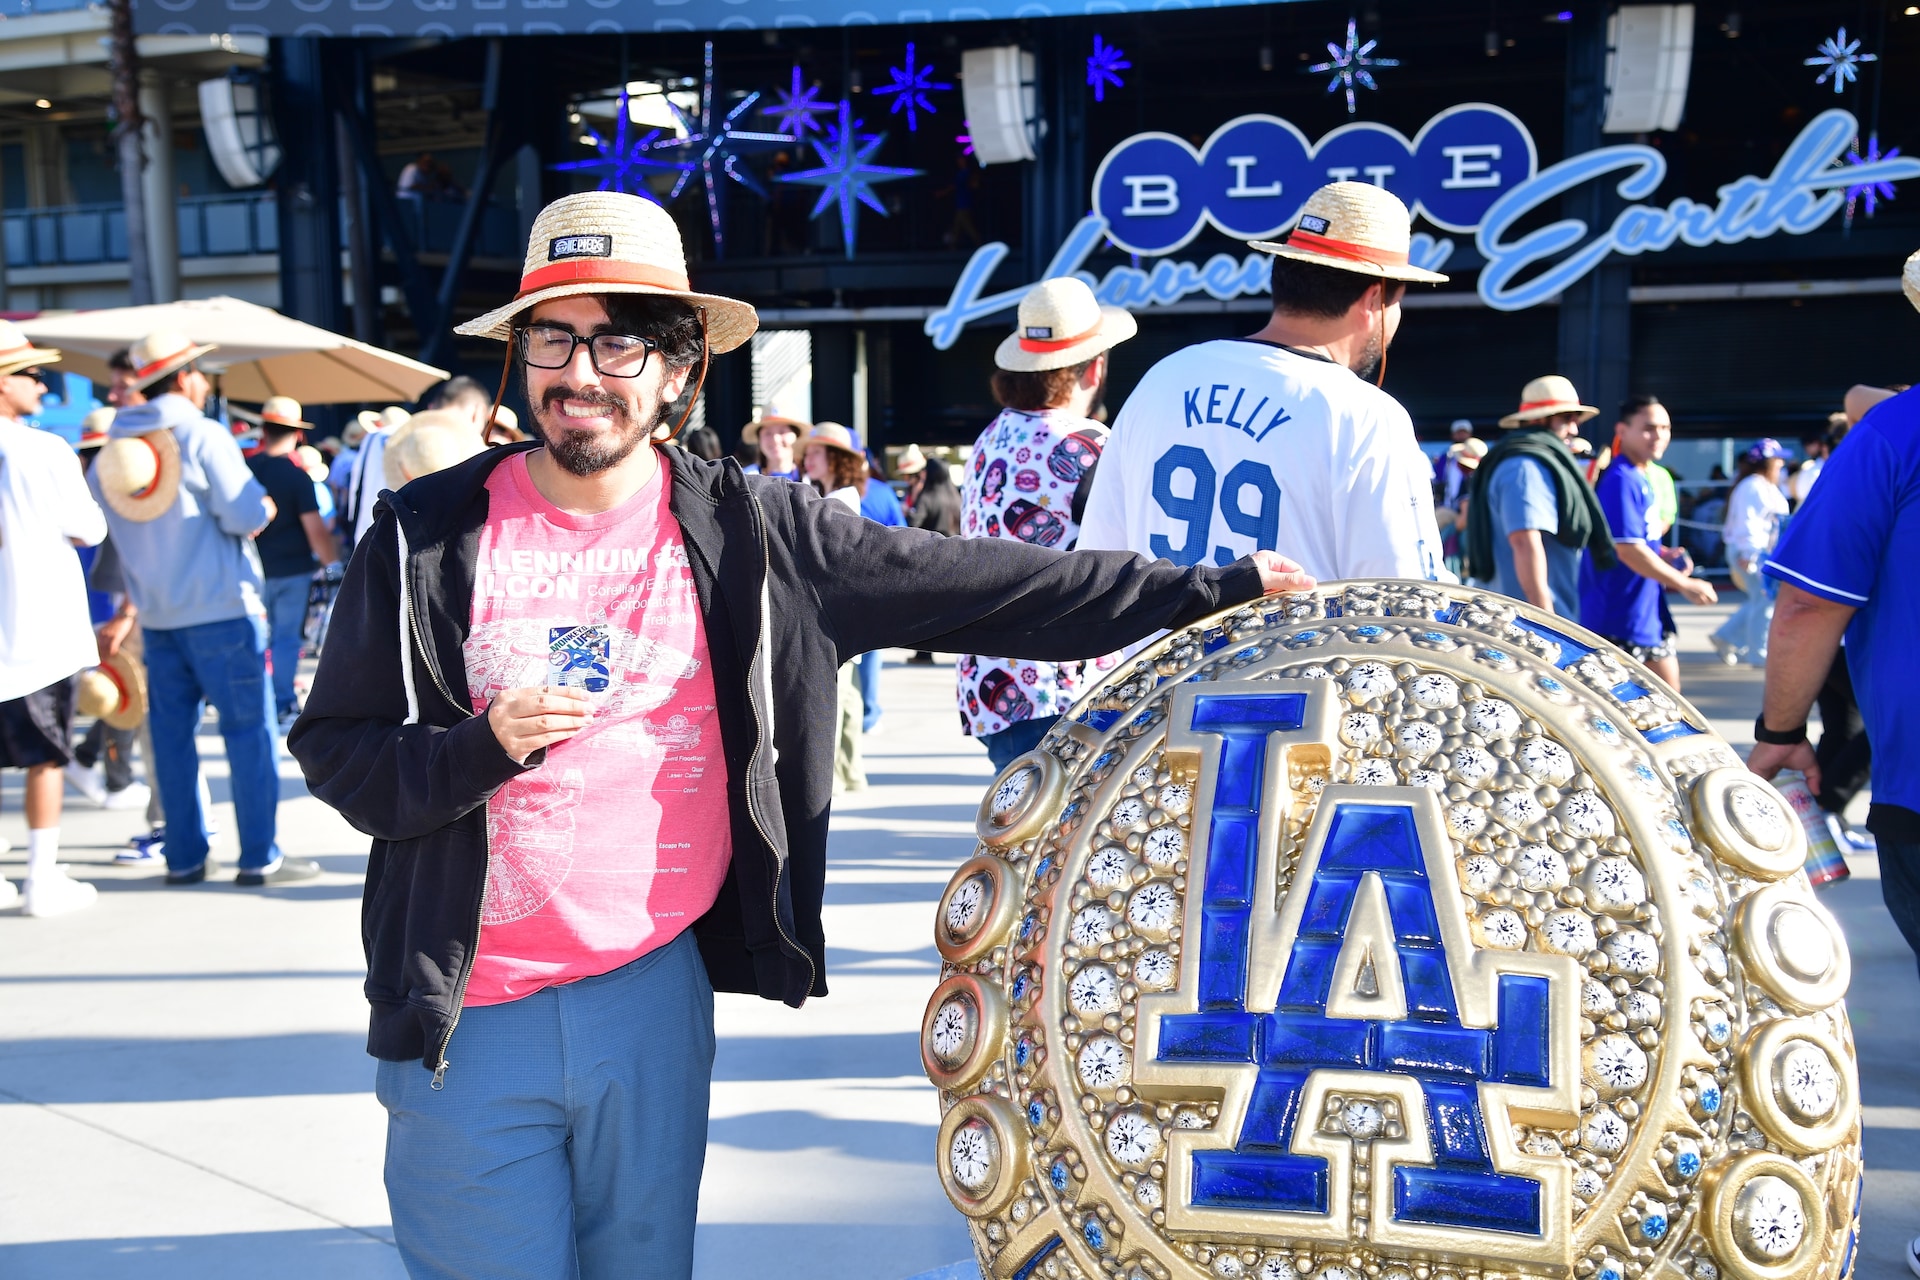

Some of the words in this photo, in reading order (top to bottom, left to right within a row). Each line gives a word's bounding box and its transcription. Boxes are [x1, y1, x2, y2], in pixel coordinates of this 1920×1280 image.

[924, 216, 1272, 350] Haven
[1476, 108, 1920, 311] Earth
[1184, 384, 1292, 443] KELLY
[1149, 443, 1282, 568] 99
[587, 582, 644, 597] Corellian
[610, 596, 681, 612] Corporation
[683, 705, 703, 713] Front
[1134, 679, 1580, 1270] LA
